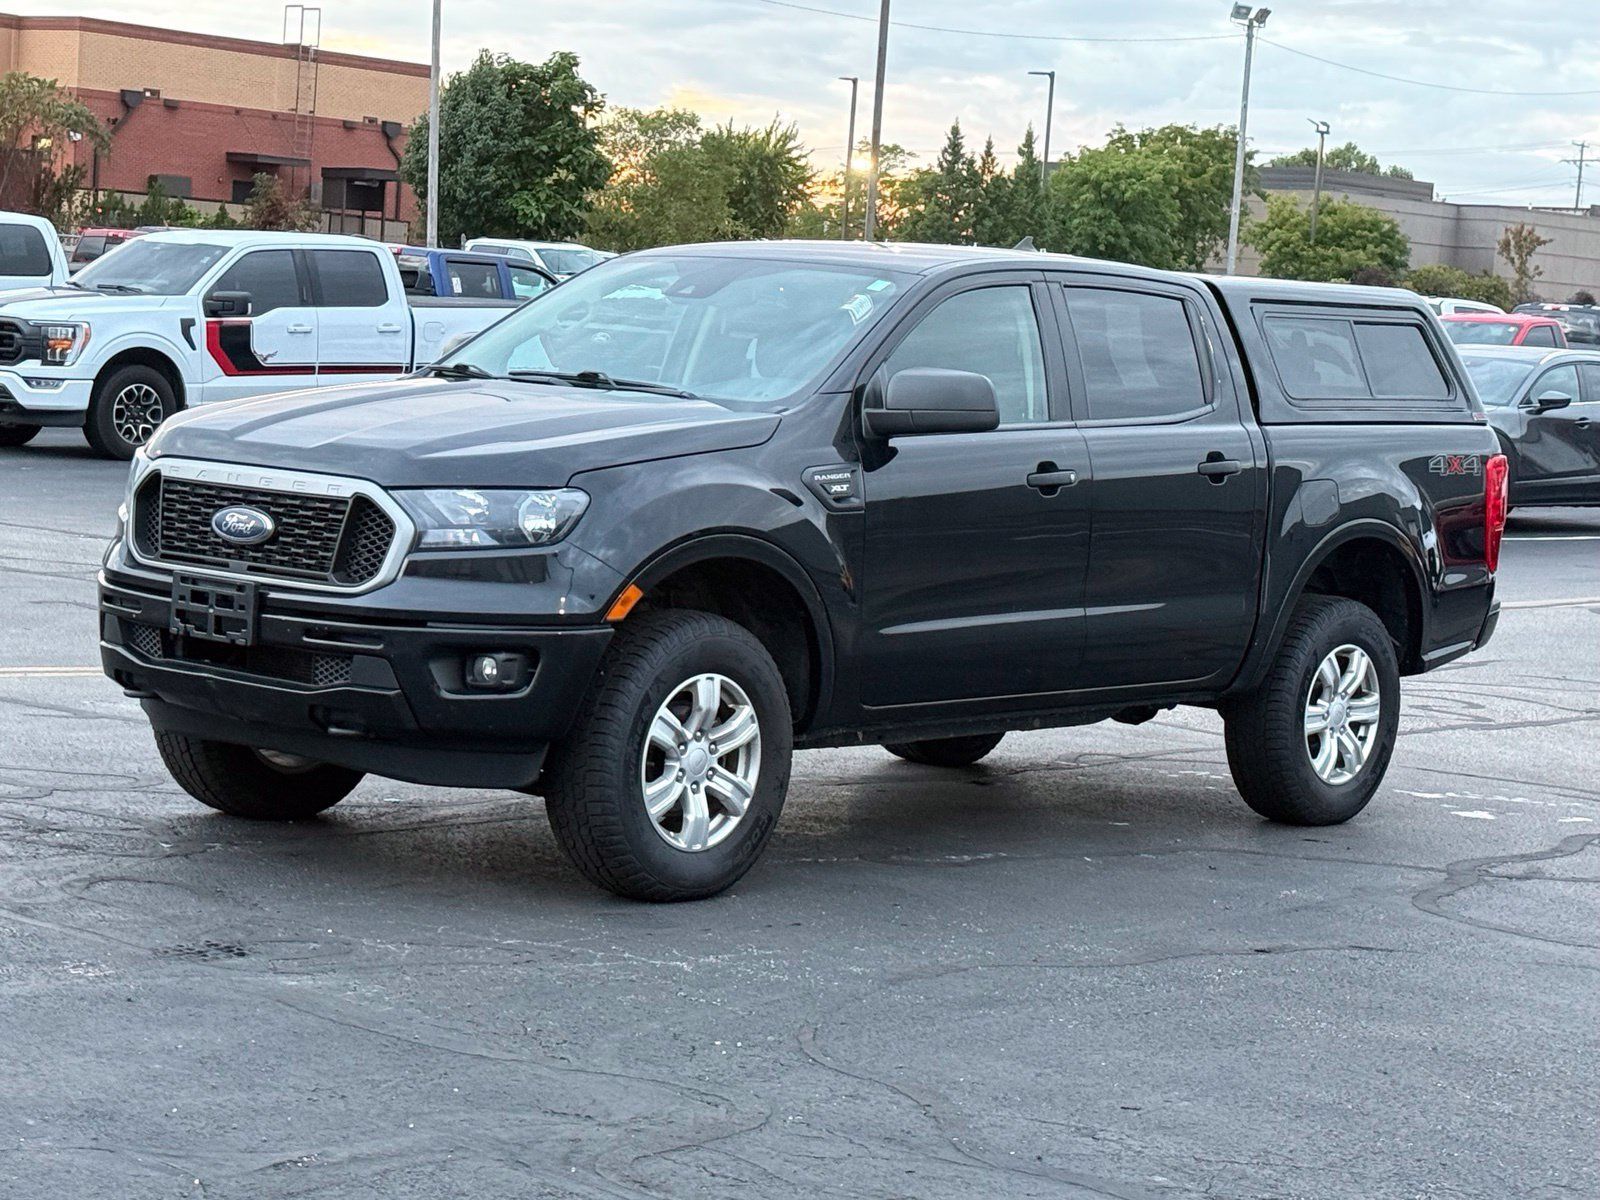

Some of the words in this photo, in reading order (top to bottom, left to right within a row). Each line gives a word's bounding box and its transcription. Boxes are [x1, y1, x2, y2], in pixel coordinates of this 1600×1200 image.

[168, 466, 342, 494] RANGER
[814, 472, 851, 481] RANGER
[830, 484, 850, 493] XLT
[221, 512, 254, 535] Ford
